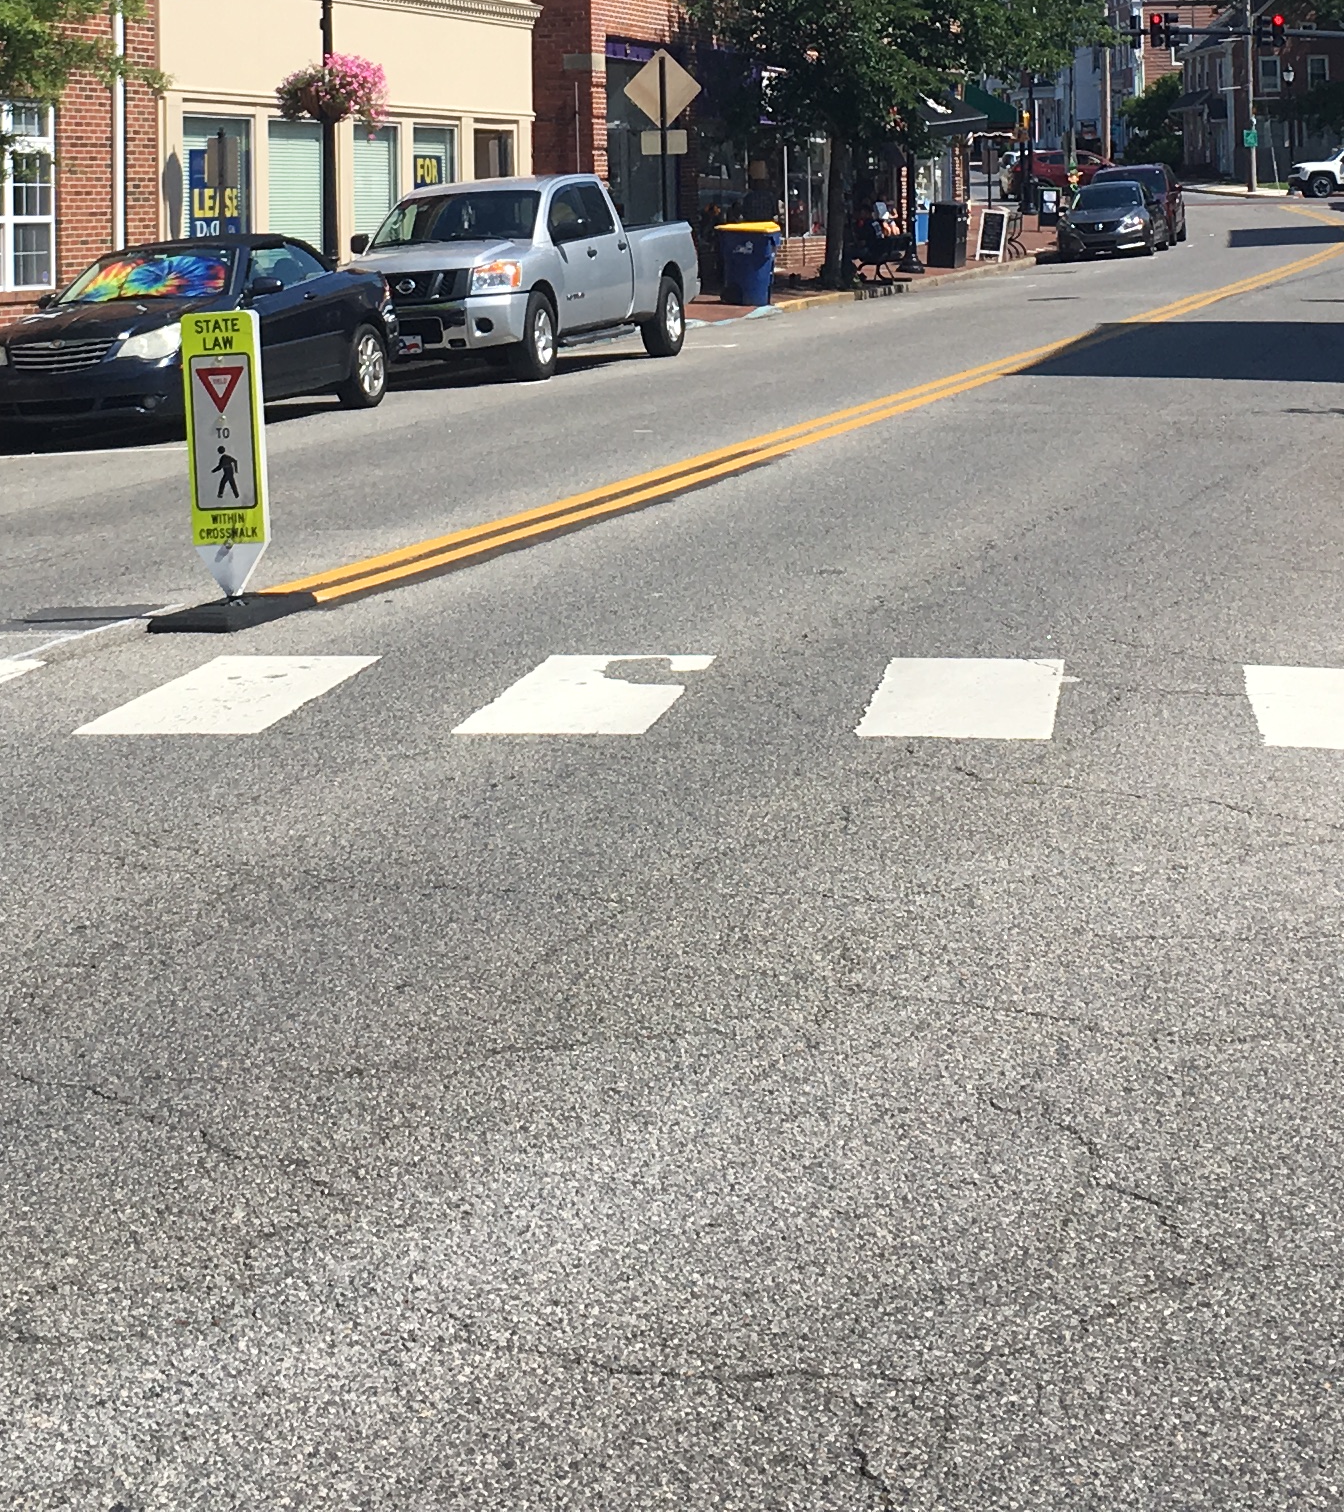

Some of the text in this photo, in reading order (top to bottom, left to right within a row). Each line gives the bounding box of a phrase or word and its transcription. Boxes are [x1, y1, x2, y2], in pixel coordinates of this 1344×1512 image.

[416, 157, 438, 184] FOR
[194, 317, 241, 335] STATE
[202, 335, 234, 351] LAW
[215, 427, 231, 439] TO
[210, 512, 245, 525] WITHIN
[198, 526, 258, 540] CROSSWALK
